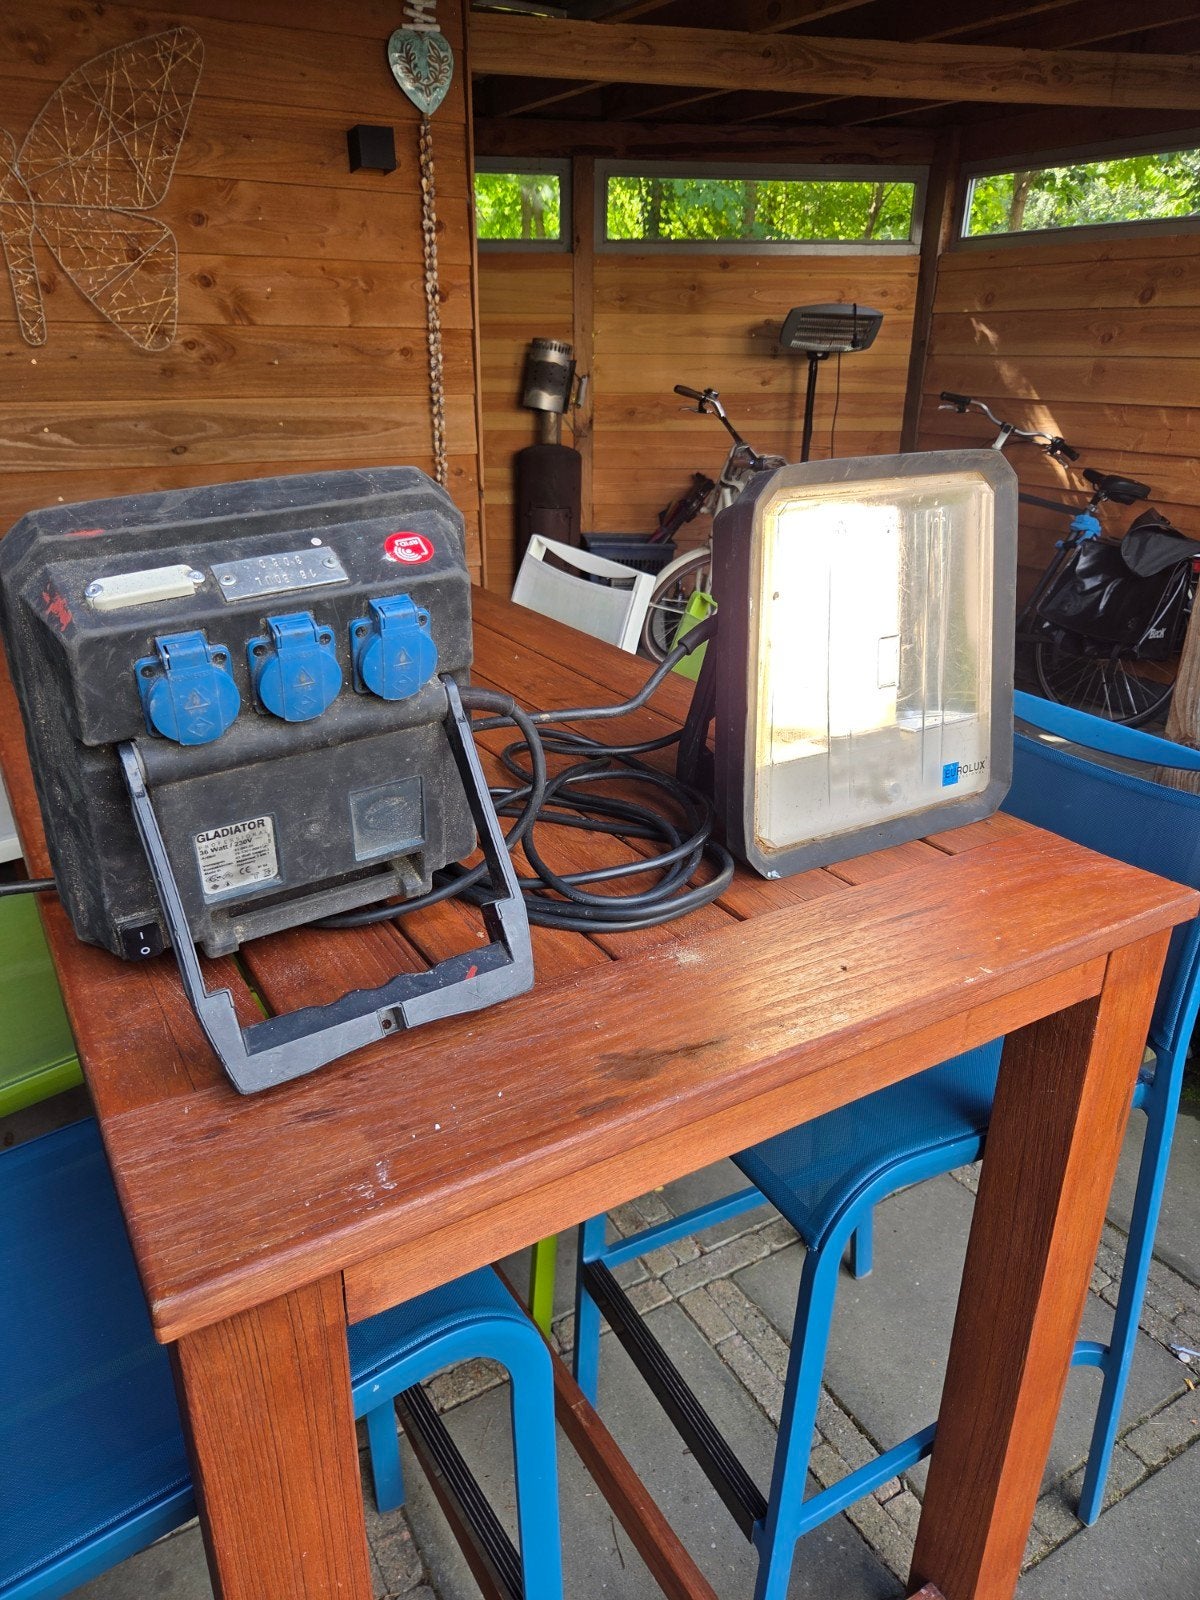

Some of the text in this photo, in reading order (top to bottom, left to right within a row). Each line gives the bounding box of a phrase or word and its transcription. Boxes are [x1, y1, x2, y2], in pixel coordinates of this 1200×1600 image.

[399, 539, 419, 547] RFID
[945, 760, 985, 779] EUROLUX
[196, 819, 266, 843] GLADIATOR
[198, 830, 268, 850] PROFESSIONAL
[210, 844, 229, 853] Watt
[234, 837, 253, 848] 230V
